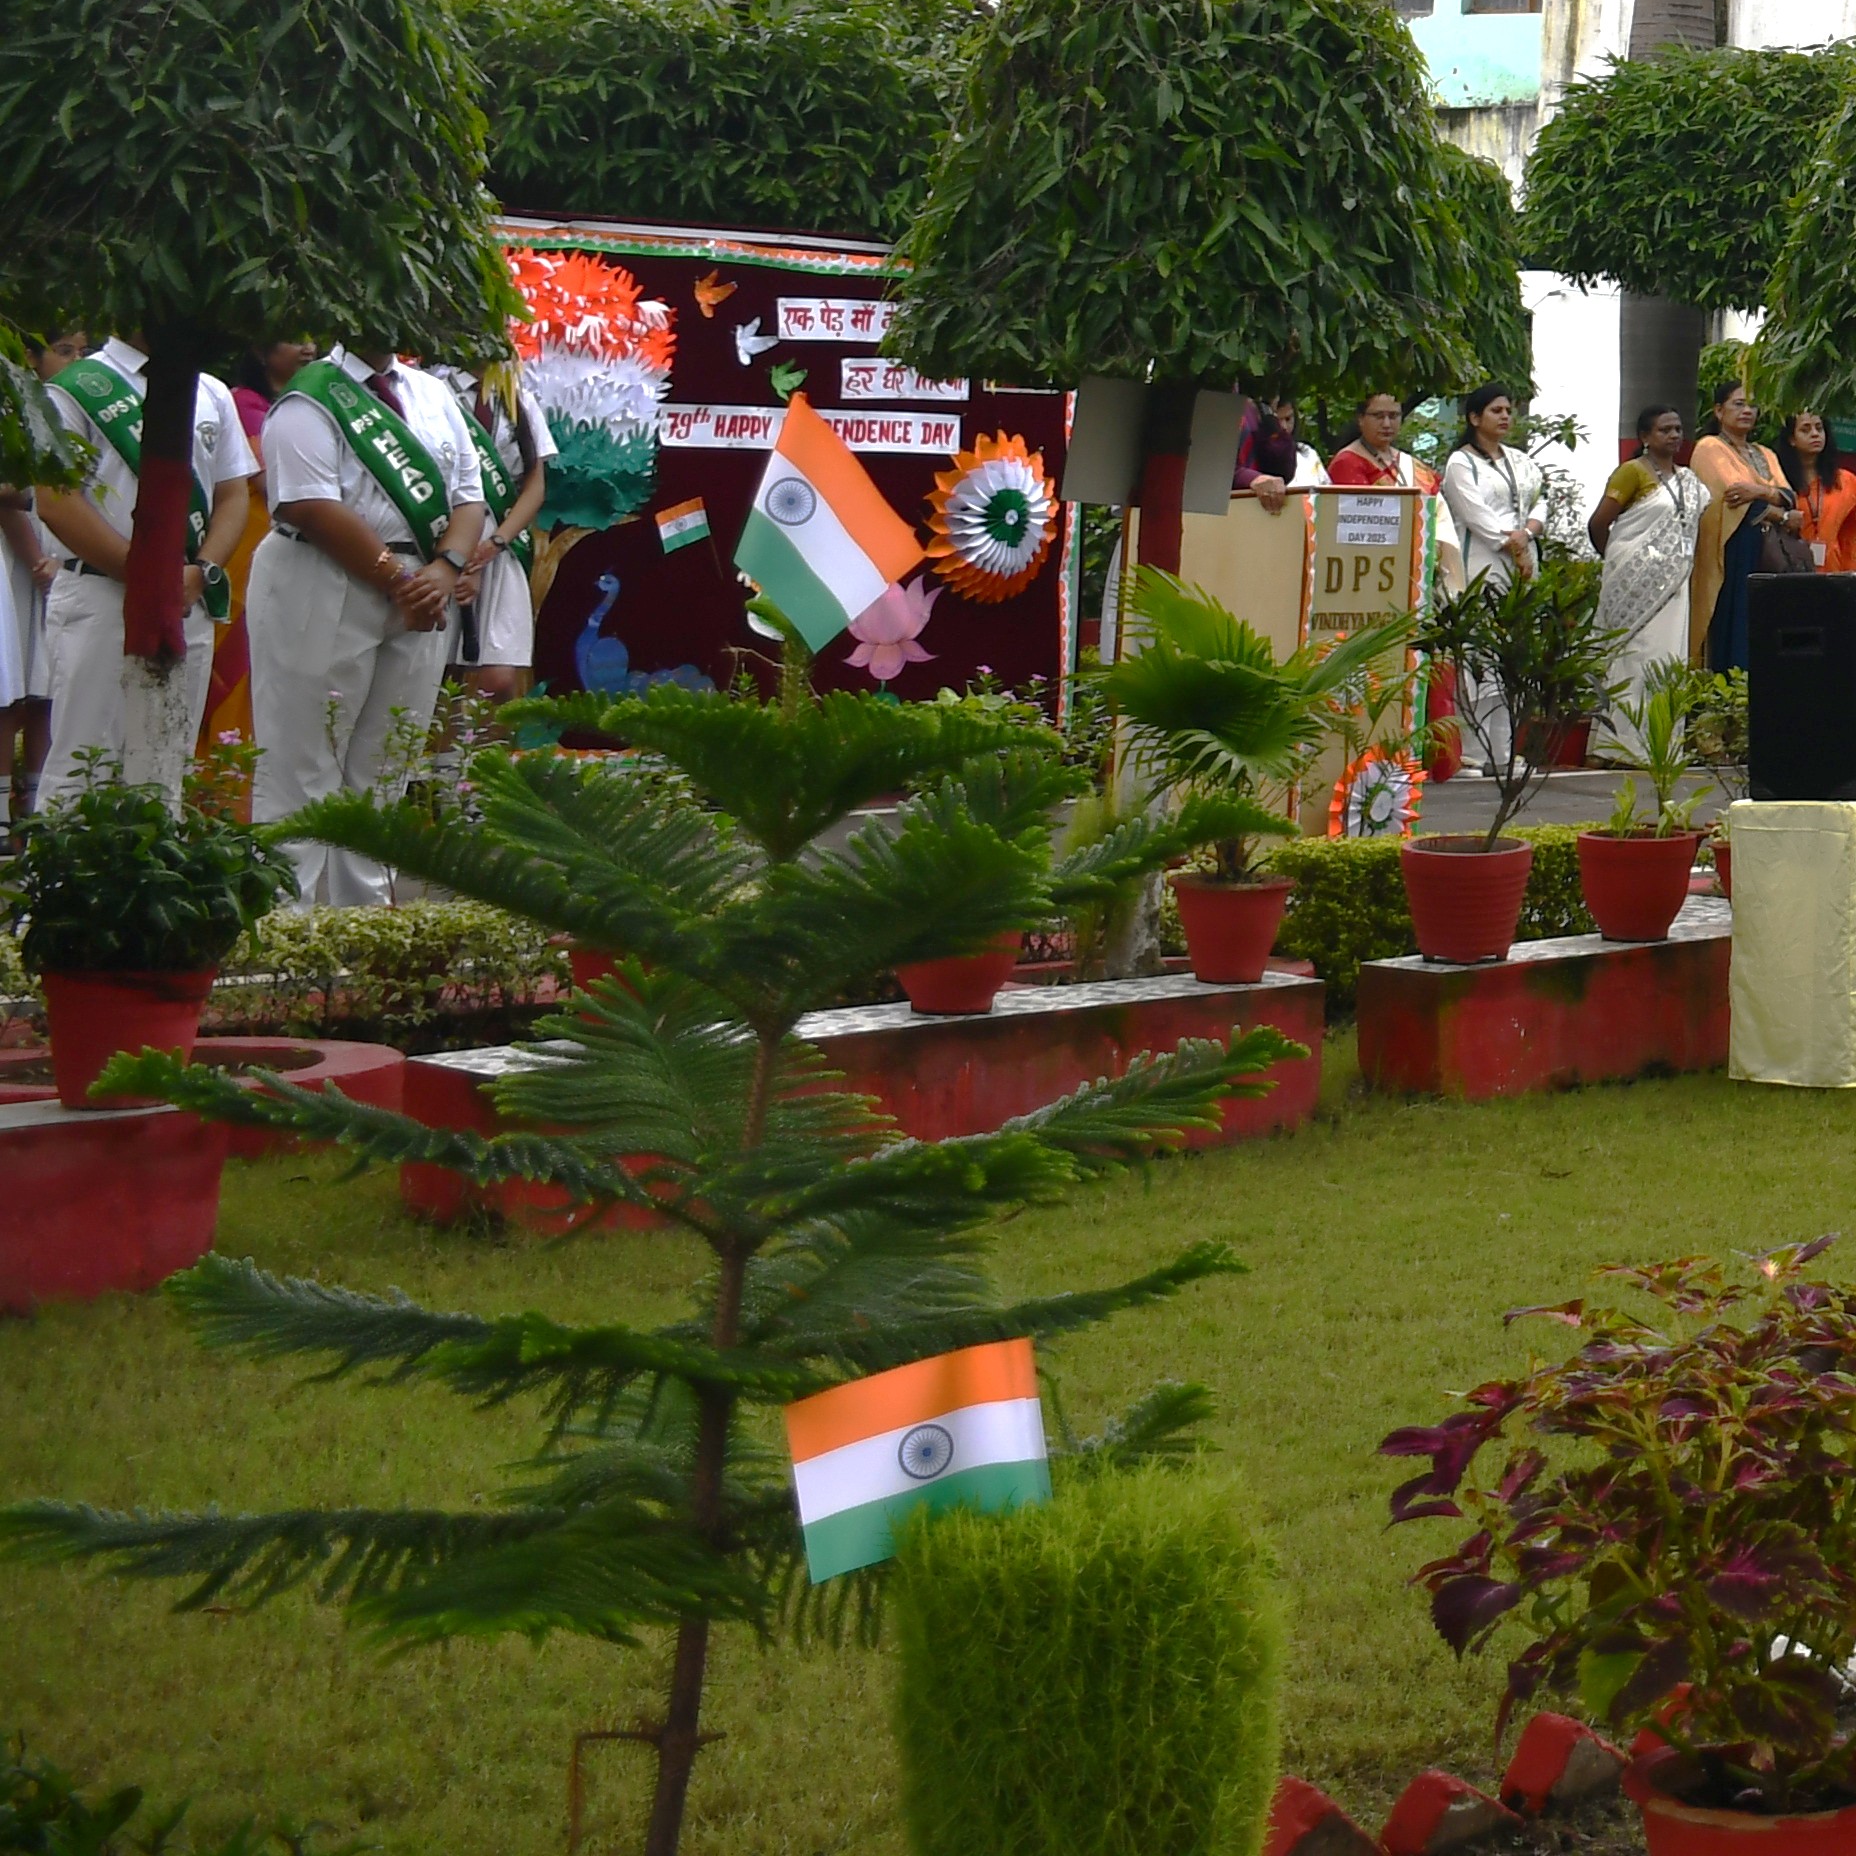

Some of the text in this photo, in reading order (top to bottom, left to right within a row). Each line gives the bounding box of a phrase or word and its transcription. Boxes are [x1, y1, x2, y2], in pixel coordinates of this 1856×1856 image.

[783, 307, 815, 337] एक
[819, 300, 845, 337] पेड़
[845, 366, 878, 395] हर
[97, 399, 130, 423] DPS
[667, 407, 711, 440] 79th
[713, 413, 773, 440] HAPPY
[920, 421, 955, 446] DAY
[372, 429, 434, 504] HEAD
[1356, 497, 1384, 507] HAPPY
[1339, 514, 1400, 526] INDEPENDENCE
[1348, 532, 1366, 542] DAY
[1325, 555, 1395, 593] DPS
